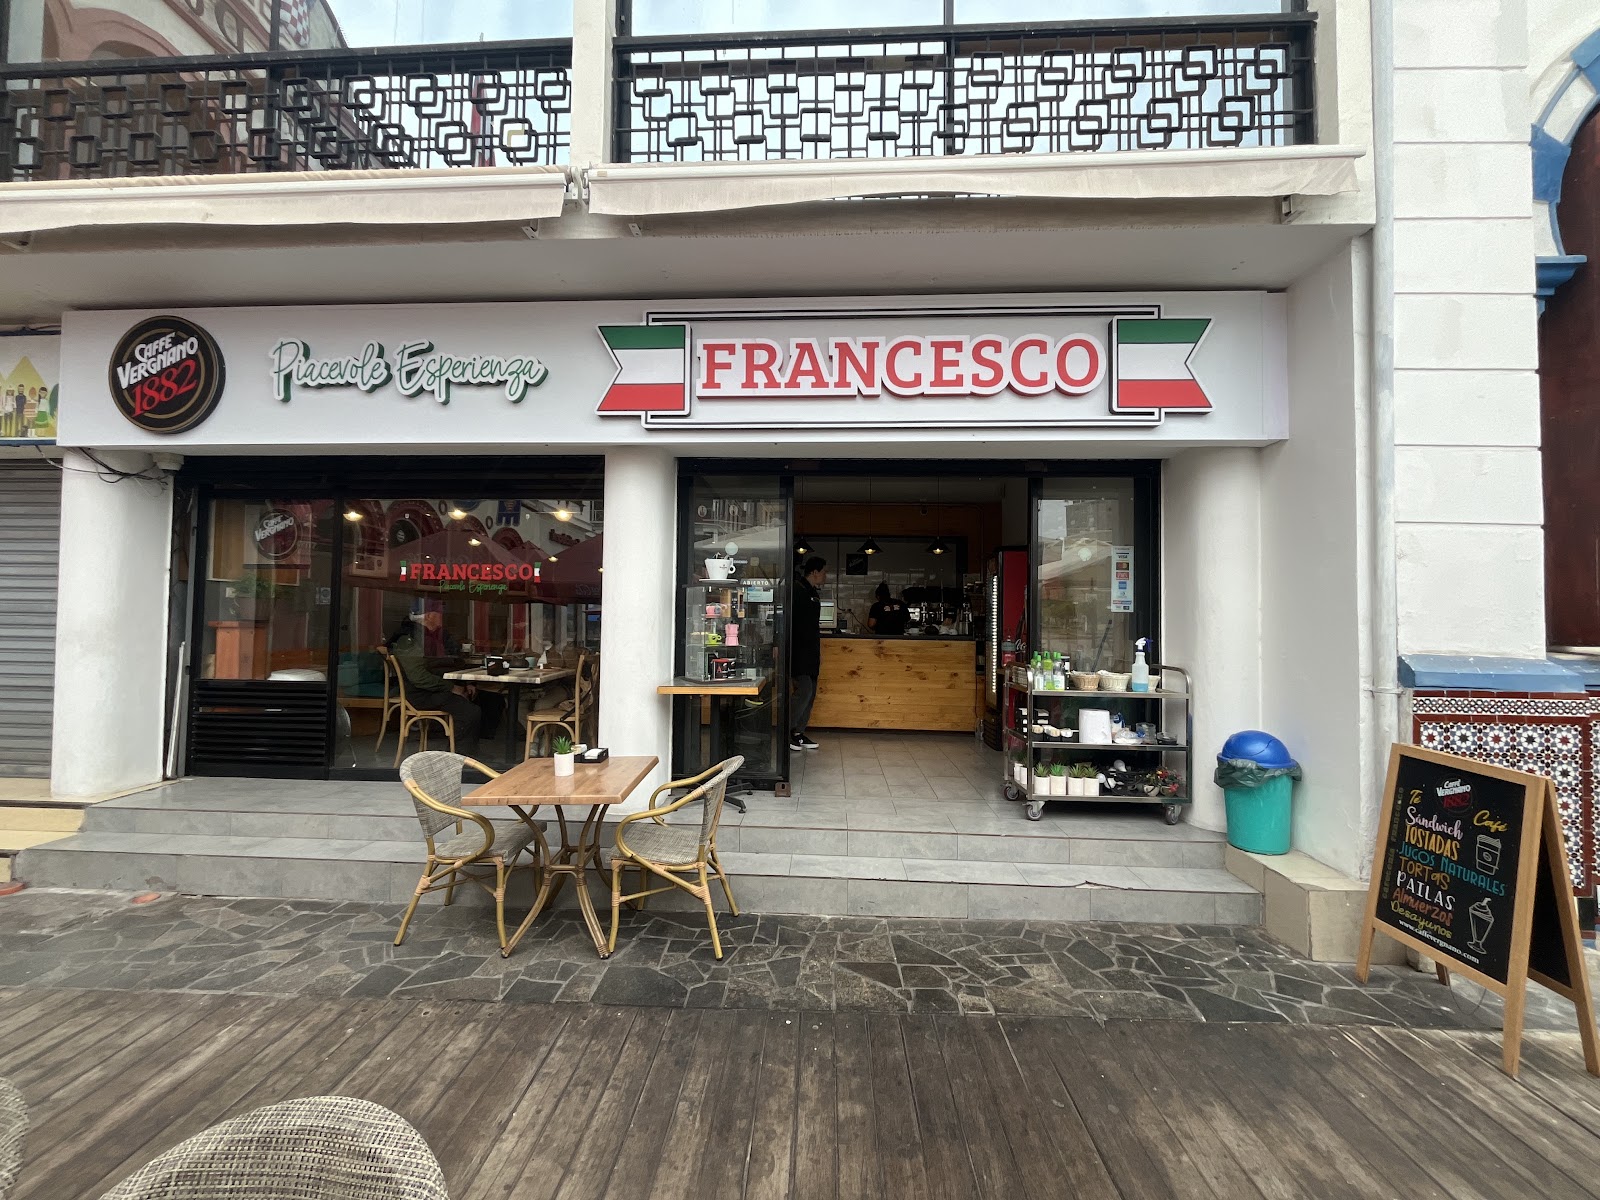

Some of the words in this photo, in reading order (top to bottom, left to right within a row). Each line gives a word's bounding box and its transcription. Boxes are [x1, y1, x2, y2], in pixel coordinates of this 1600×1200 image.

[117, 337, 198, 389] VERGNANO
[271, 340, 387, 399] Piacevole
[396, 340, 543, 400] Esperienza
[700, 338, 1101, 396] FRANCESCO
[132, 360, 197, 417] 1882
[410, 563, 533, 581] FRANCESCO
[1405, 806, 1463, 840] Sándwich
[1405, 823, 1460, 861] TOSTADAS
[1473, 810, 1508, 832] Café
[1399, 841, 1435, 866] JUGOS
[1440, 856, 1506, 896] NATURALES
[1390, 900, 1453, 939] Desayunos
[1398, 919, 1480, 964] www.caffevergnano.com
